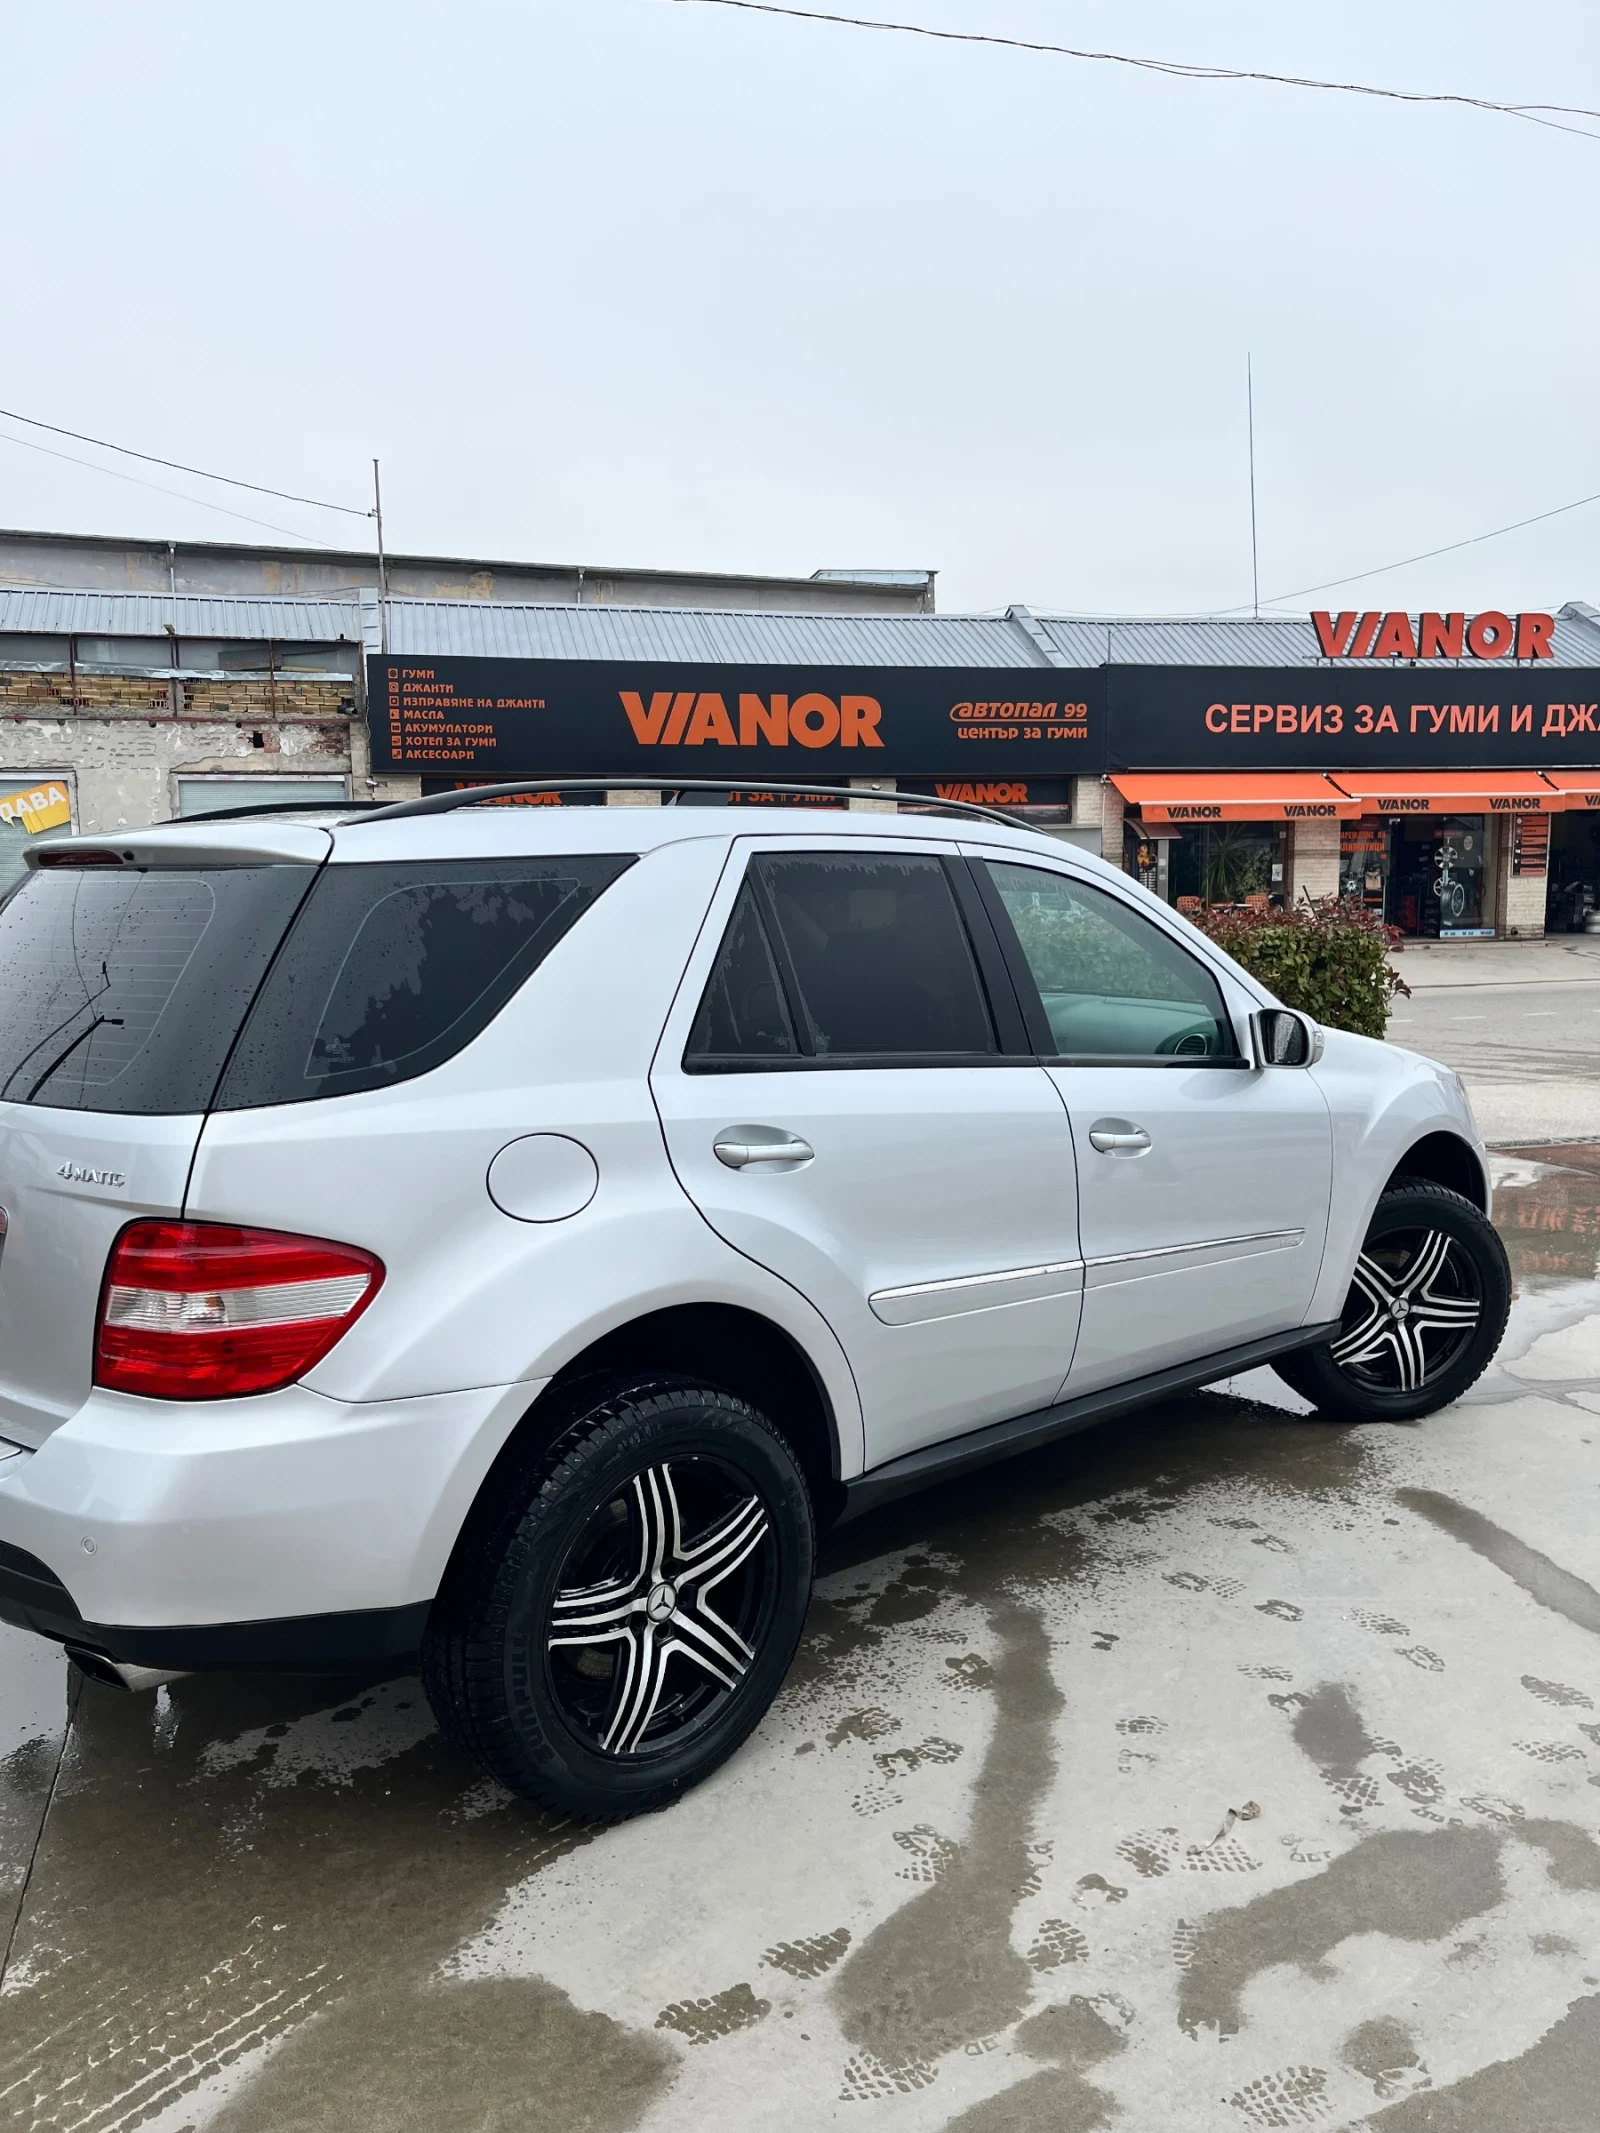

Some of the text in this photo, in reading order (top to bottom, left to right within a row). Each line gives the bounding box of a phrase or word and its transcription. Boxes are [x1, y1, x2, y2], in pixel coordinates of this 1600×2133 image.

[1311, 611, 1555, 660] VIANOR
[402, 669, 435, 679] ГУМИ
[403, 683, 454, 693] ДЖАНТИ
[403, 697, 545, 708] ИЗПРАВЯНЕ НА ДЖАНТИ
[403, 710, 444, 720] МАСЛА
[1064, 703, 1088, 718] 99
[619, 691, 885, 748] VIANOR
[1205, 703, 1600, 737] СЕРВИЗ ЗА ГУМИ И ДЖ
[405, 723, 493, 734] АКУМУЛАТОРИ
[957, 727, 1088, 740] център за гуми
[405, 736, 497, 747] ХОТЕЛ ЗА ГУМИ
[406, 749, 475, 760] АКСЕСОАРИ
[934, 783, 1028, 804] VIANOR
[1377, 798, 1430, 811] VIANOR
[1488, 797, 1541, 810] VIANOR
[1166, 806, 1222, 819] VIANOR
[1283, 804, 1337, 817] VIANOR
[56, 1161, 126, 1188] 4MATIC
